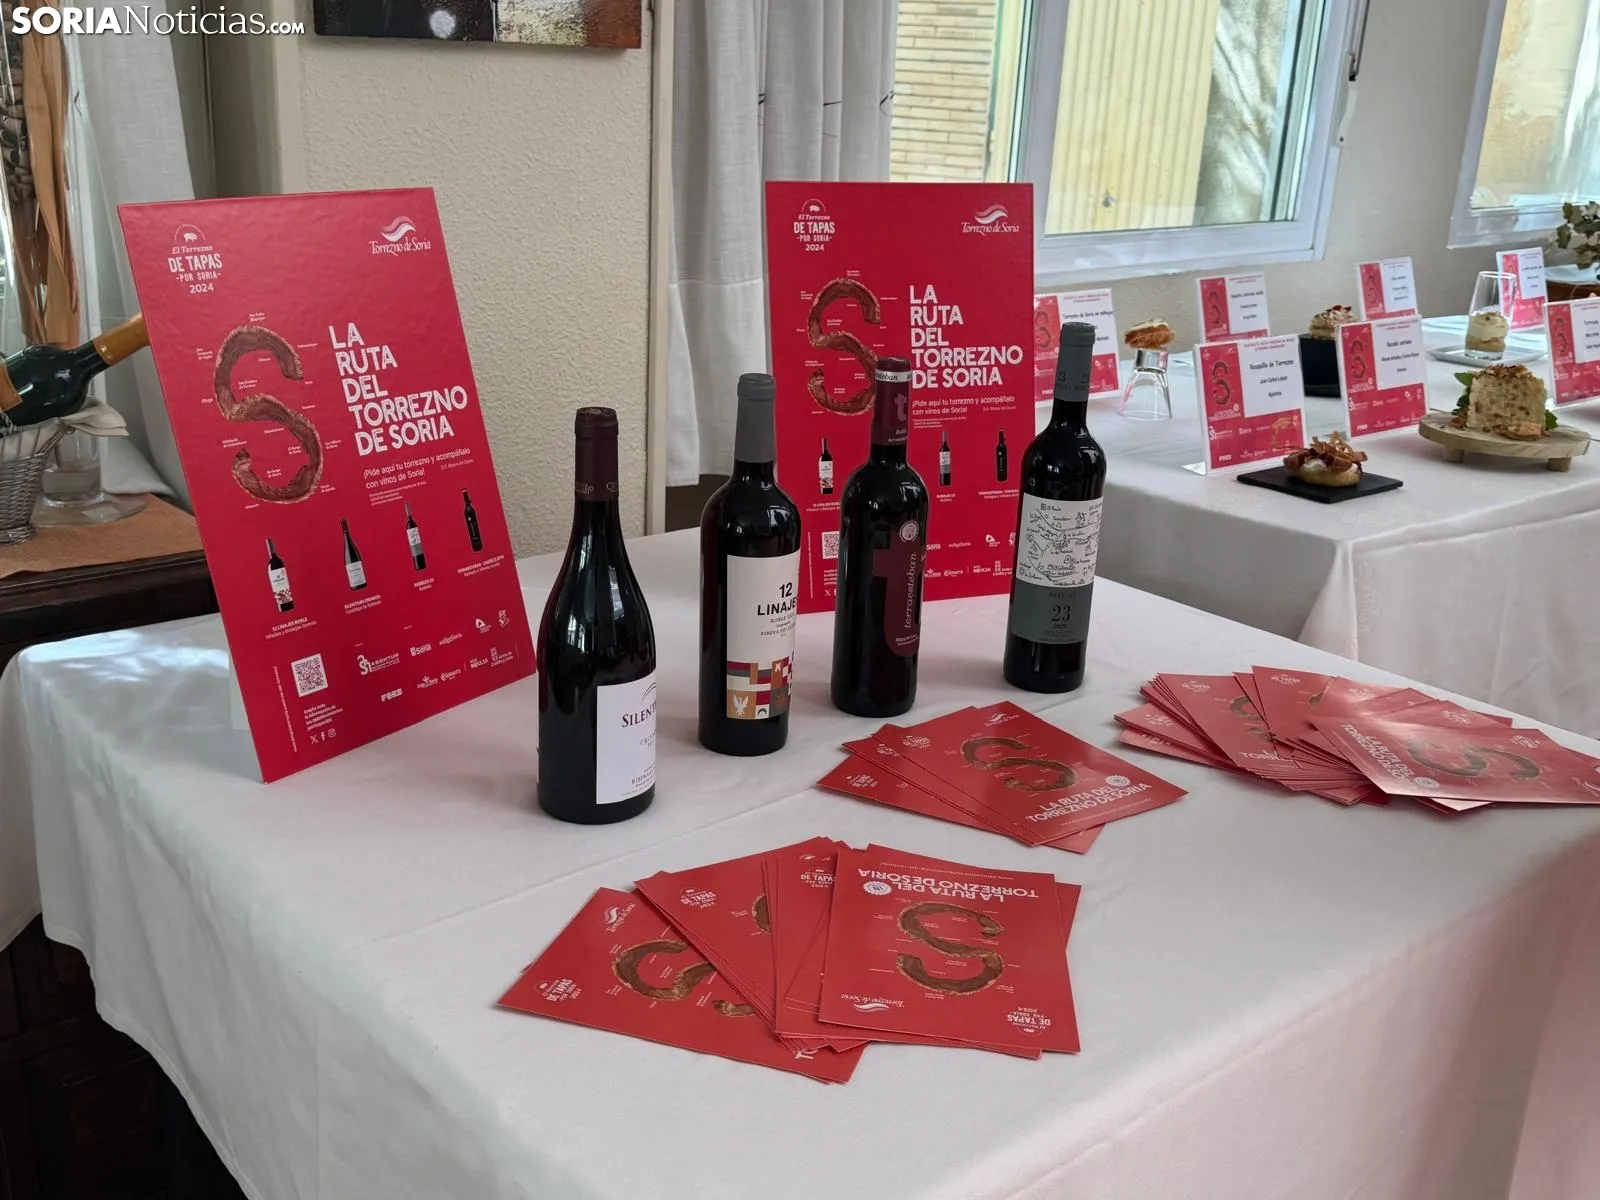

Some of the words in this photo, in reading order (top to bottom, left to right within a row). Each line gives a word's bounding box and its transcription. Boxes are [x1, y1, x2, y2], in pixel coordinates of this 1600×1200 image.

[793, 221, 805, 234] DE
[807, 221, 835, 234] TAPAS
[961, 221, 992, 237] Torrezno
[1000, 221, 1020, 233] Soria
[368, 240, 403, 257] Torrezno
[411, 236, 432, 251] Soria
[805, 243, 825, 251] 2024
[168, 257, 185, 272] DE
[185, 253, 223, 271] TAPAS
[189, 283, 215, 294] 2024
[909, 284, 938, 305] LA
[910, 305, 964, 326] RUTA
[328, 322, 365, 349] LA
[911, 327, 949, 347] DEL
[335, 345, 398, 376] RUTA
[911, 345, 1024, 368] TORREZNO
[912, 369, 938, 389] DE
[942, 366, 1003, 389] SORIA
[342, 374, 389, 404] DEL
[348, 385, 468, 429] TORREZNO
[354, 427, 388, 456] DE
[388, 415, 455, 449] SORIA
[396, 462, 404, 471] tu
[404, 457, 430, 469] torrezno
[430, 455, 436, 465] y
[365, 480, 379, 489] con
[379, 475, 398, 486] vinos
[398, 472, 407, 482] de
[779, 582, 793, 599] 12
[904, 552, 917, 629] terraesteban
[1050, 605, 1071, 622] 23
[1025, 799, 1098, 823] TORREZNO
[1096, 793, 1117, 804] DE
[1114, 782, 1153, 799] SORIA
[1039, 800, 1062, 812] LA
[1058, 791, 1094, 806] RUTA
[1091, 785, 1120, 797] DEL
[857, 868, 911, 884] SORIA
[912, 876, 935, 887] DE
[892, 881, 926, 893] DEL
[931, 886, 977, 900] RUTA
[939, 880, 1040, 898] TORREZNO
[690, 891, 716, 902] TAPAS
[980, 891, 1004, 903] LA
[871, 996, 905, 1008] Torrezno
[1007, 1014, 1036, 1024] TAPAS
[1038, 1018, 1051, 1026] DE
